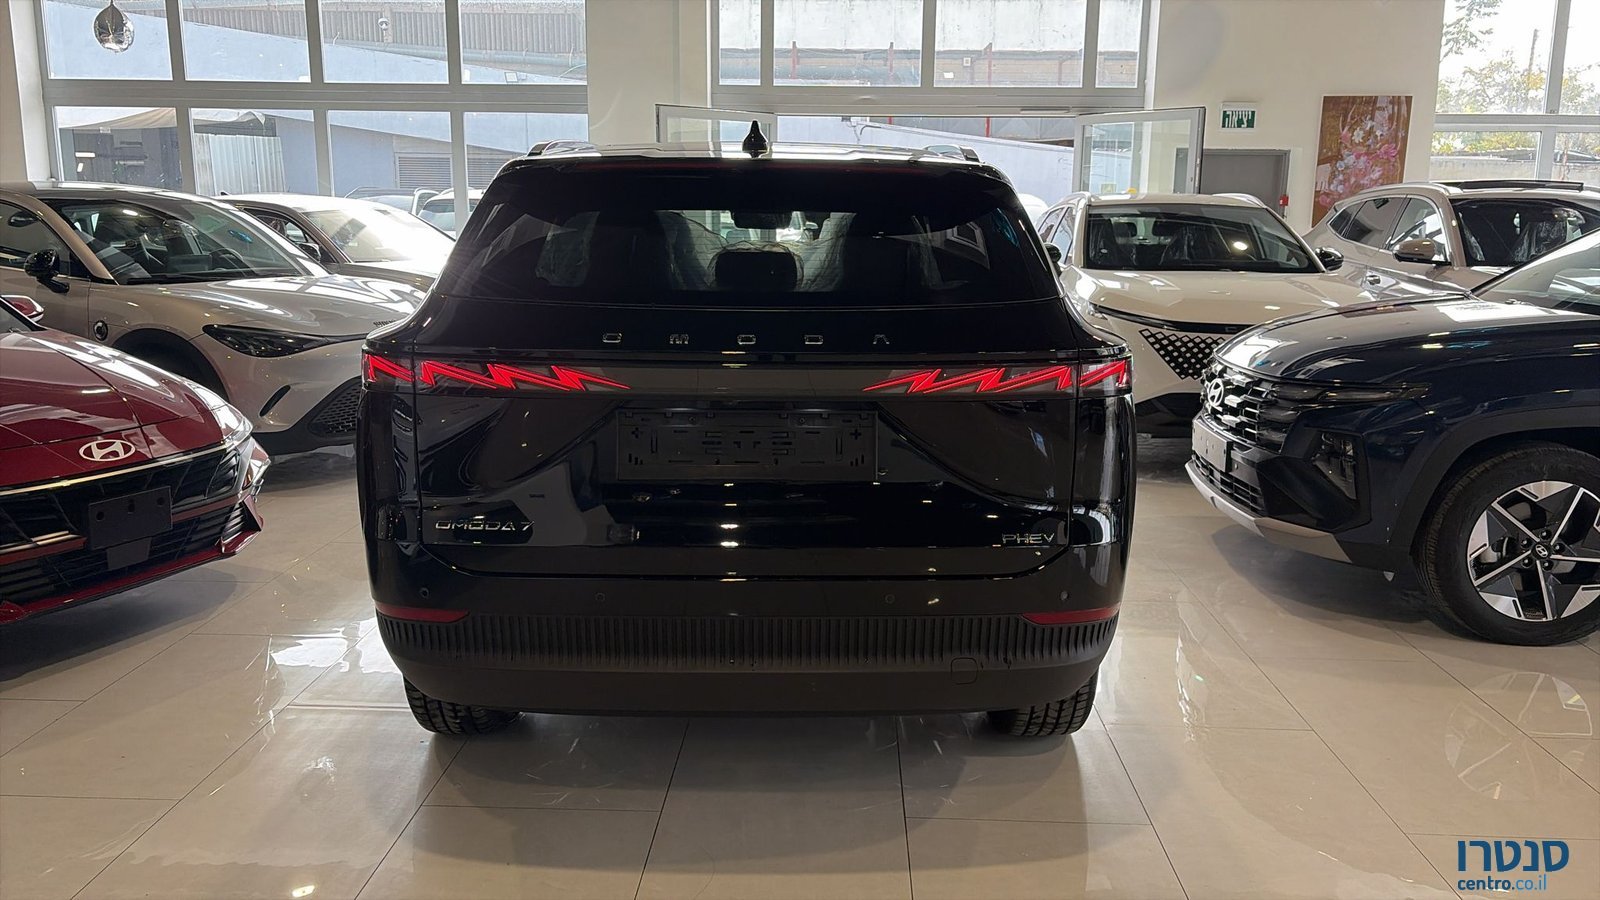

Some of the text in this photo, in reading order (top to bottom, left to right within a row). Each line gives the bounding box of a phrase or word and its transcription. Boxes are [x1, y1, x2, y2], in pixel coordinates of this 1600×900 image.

[1225, 111, 1252, 128] יציאה
[602, 332, 890, 345] OMODA
[435, 520, 535, 531] OMODA 7
[1002, 533, 1055, 544] PHEV
